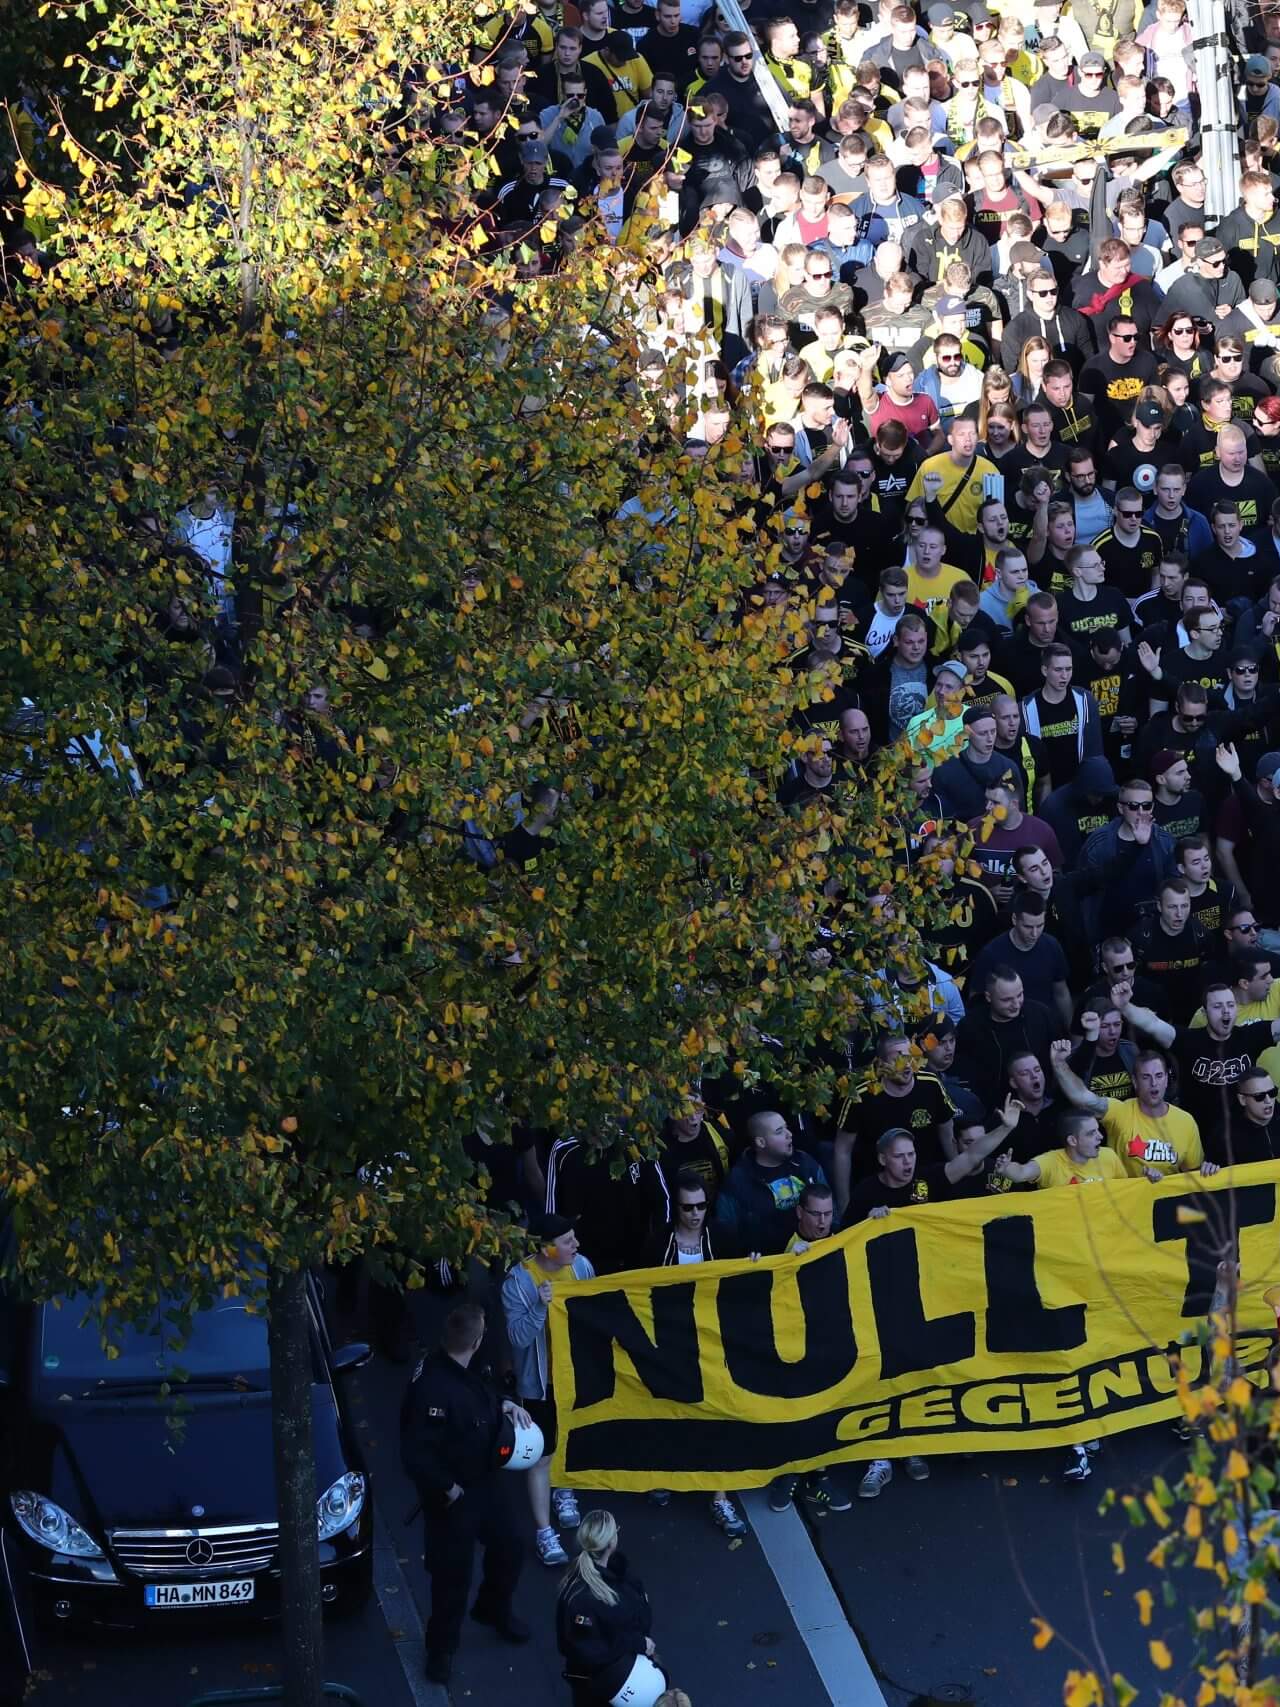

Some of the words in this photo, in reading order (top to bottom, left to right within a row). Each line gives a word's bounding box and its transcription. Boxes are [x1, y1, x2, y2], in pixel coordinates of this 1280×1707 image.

[1147, 1138, 1173, 1154] The
[1144, 1150, 1178, 1164] Unity
[565, 1214, 1088, 1411] NULL
[156, 1587, 180, 1604] HA
[192, 1584, 216, 1602] MN
[219, 1582, 252, 1600] 849
